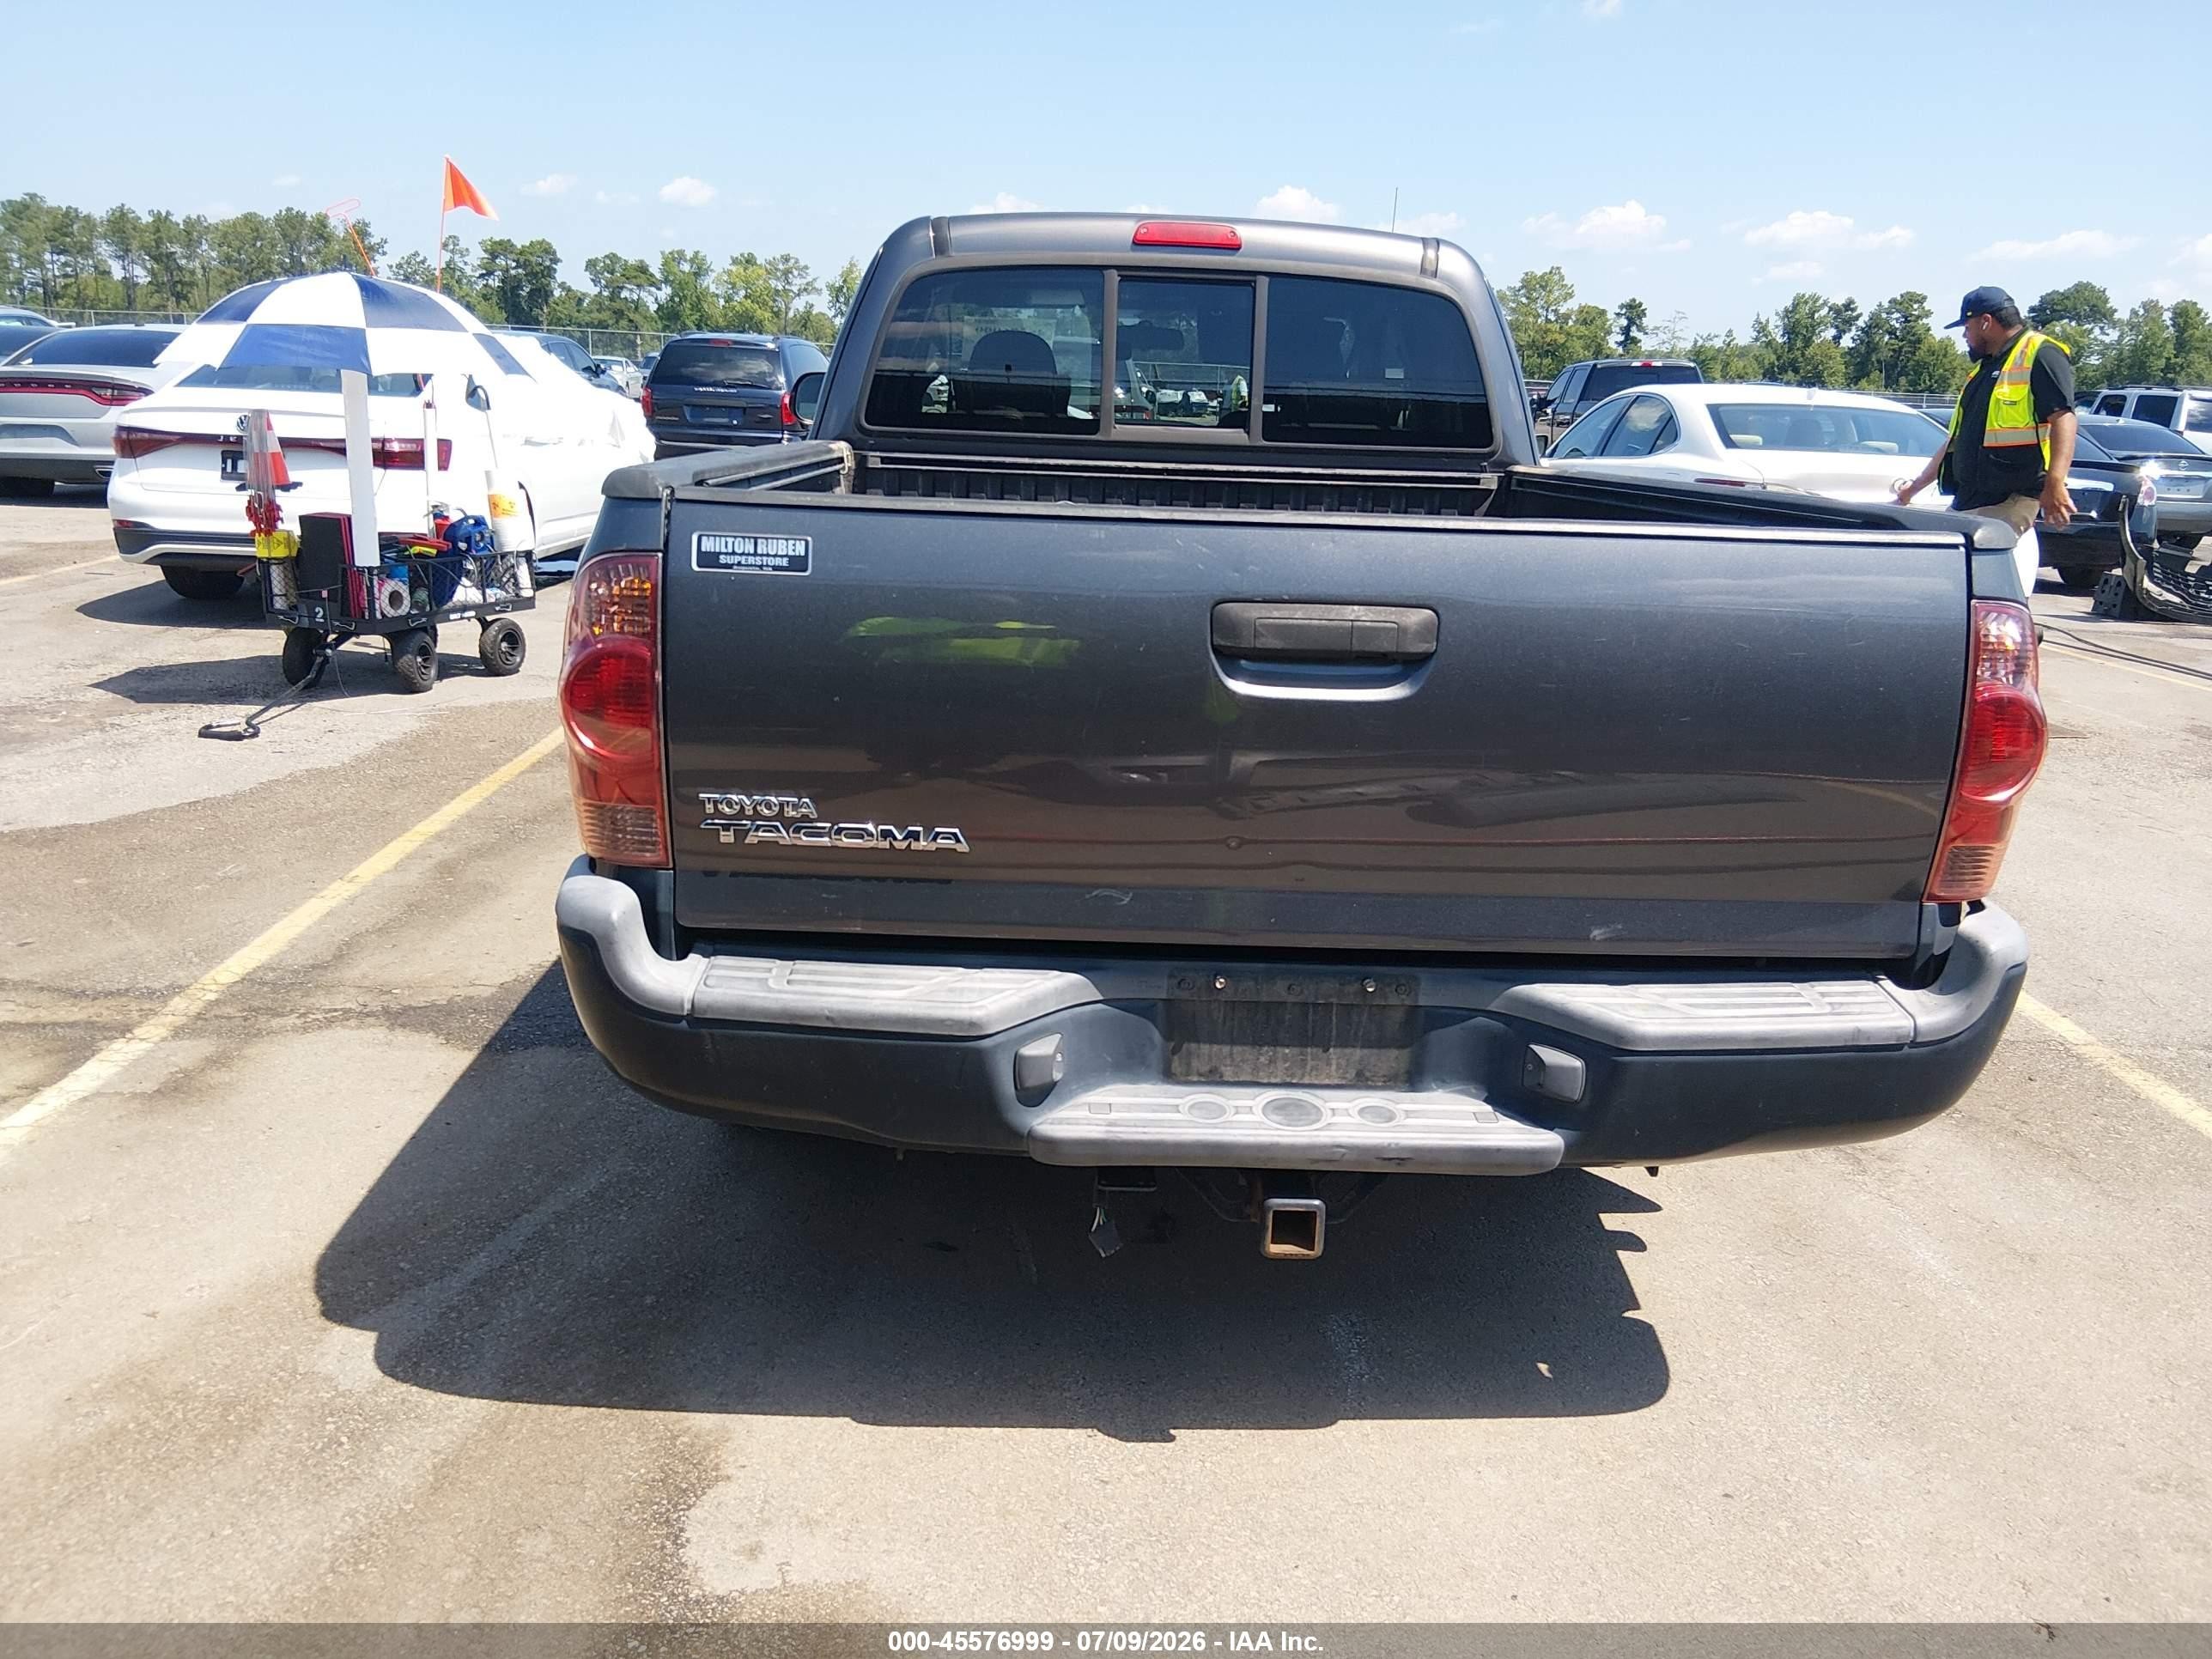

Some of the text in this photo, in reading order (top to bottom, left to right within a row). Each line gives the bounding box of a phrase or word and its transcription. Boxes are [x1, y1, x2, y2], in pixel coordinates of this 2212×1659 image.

[701, 536, 805, 556] MILTON RUBEN
[719, 555, 789, 567] SUPERSTORE
[314, 606, 325, 622] 2
[698, 793, 818, 818] TOYOTA
[700, 819, 970, 853] TACOMA
